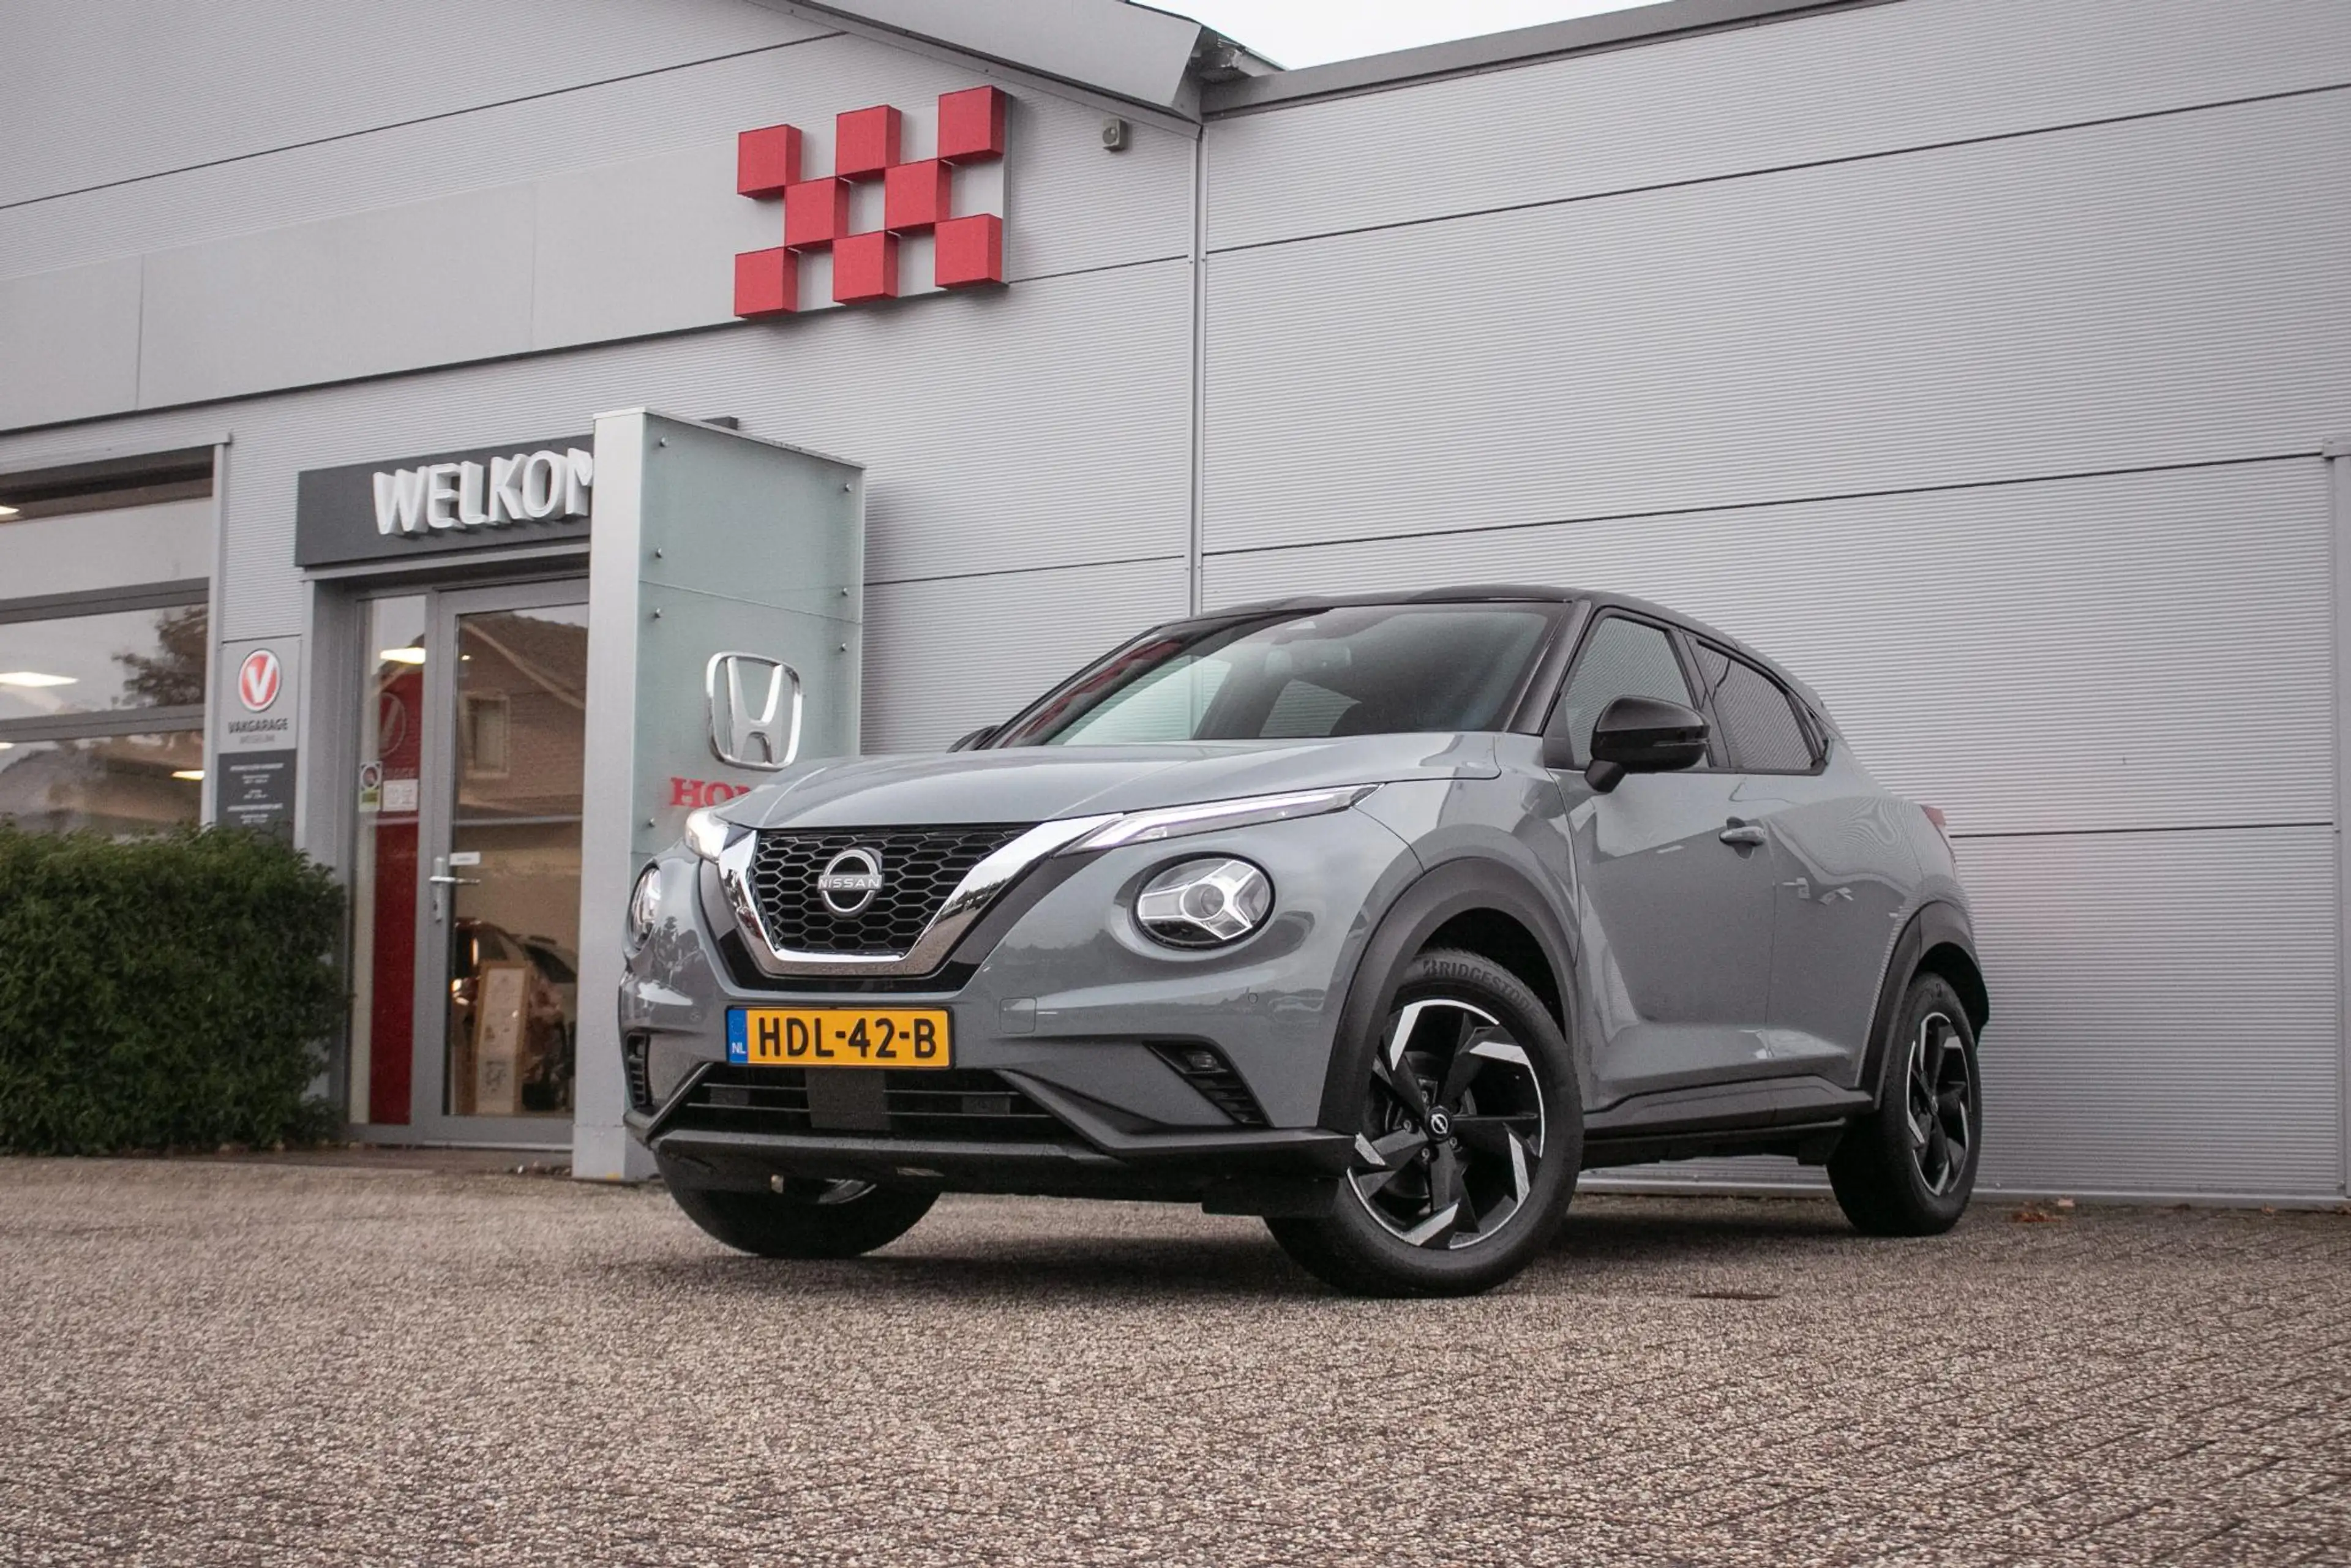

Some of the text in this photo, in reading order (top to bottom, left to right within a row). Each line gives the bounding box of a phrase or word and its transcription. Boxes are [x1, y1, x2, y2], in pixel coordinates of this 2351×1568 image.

[818, 878, 881, 888] NISSAN
[759, 1017, 937, 1058] HDL-42-B
[732, 1041, 746, 1055] NL
